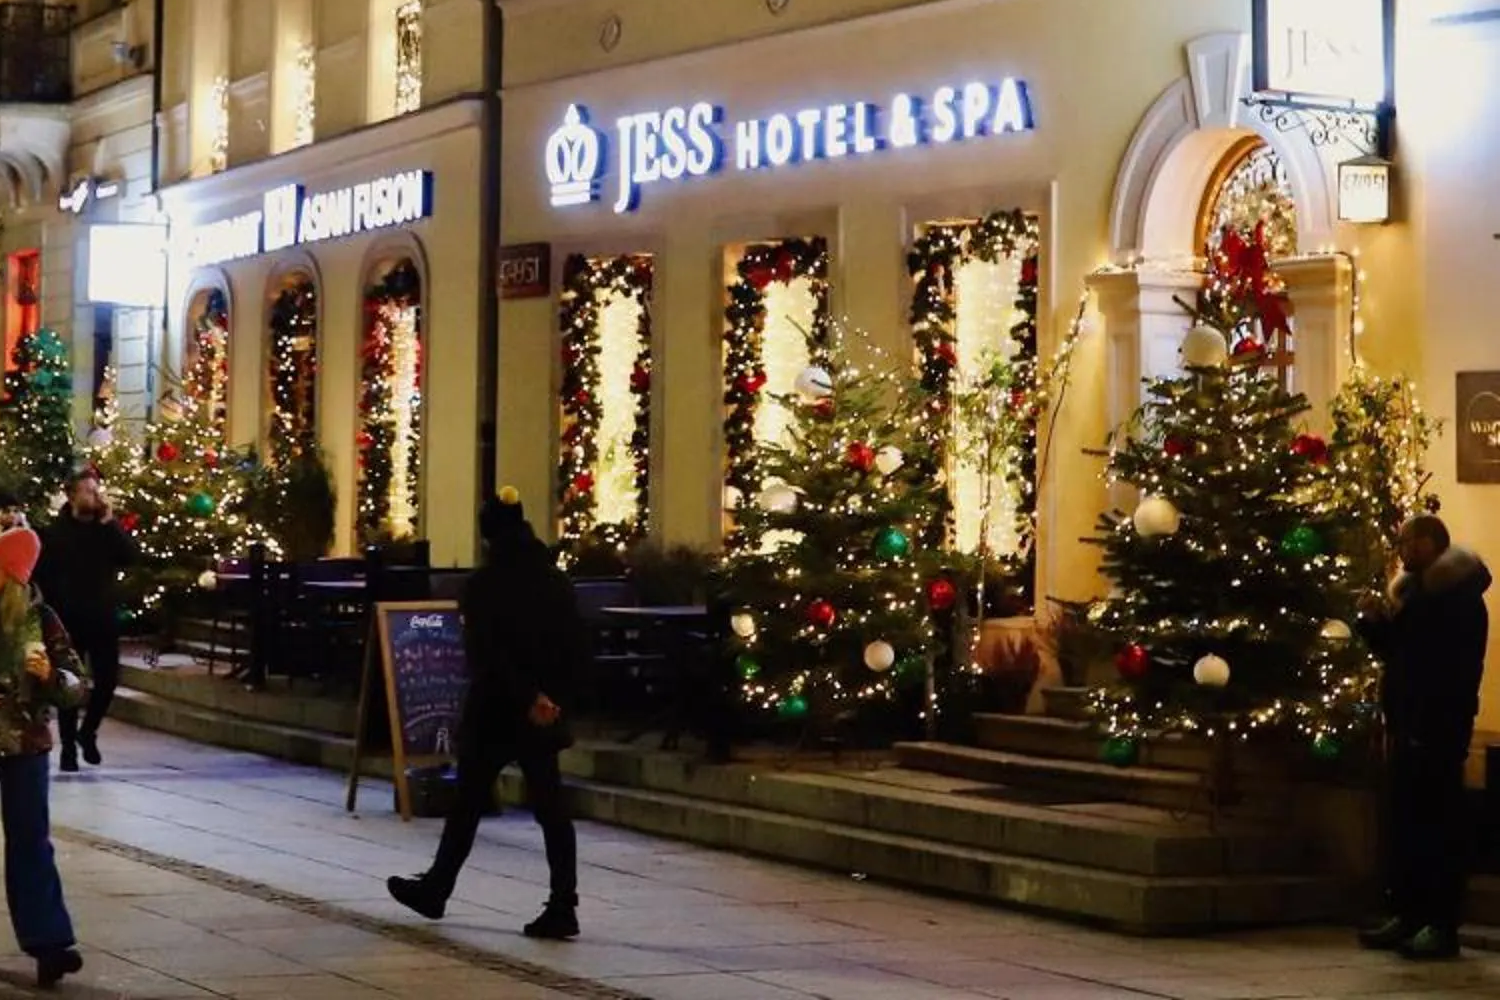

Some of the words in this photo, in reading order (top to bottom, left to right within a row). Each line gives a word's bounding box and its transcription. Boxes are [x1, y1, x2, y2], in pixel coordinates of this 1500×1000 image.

[612, 101, 717, 214] JESS
[735, 100, 876, 170] HOTEL
[889, 91, 919, 147] &
[930, 76, 1028, 143] SPA
[298, 188, 351, 242] ASIAN
[354, 169, 423, 231] FUSION
